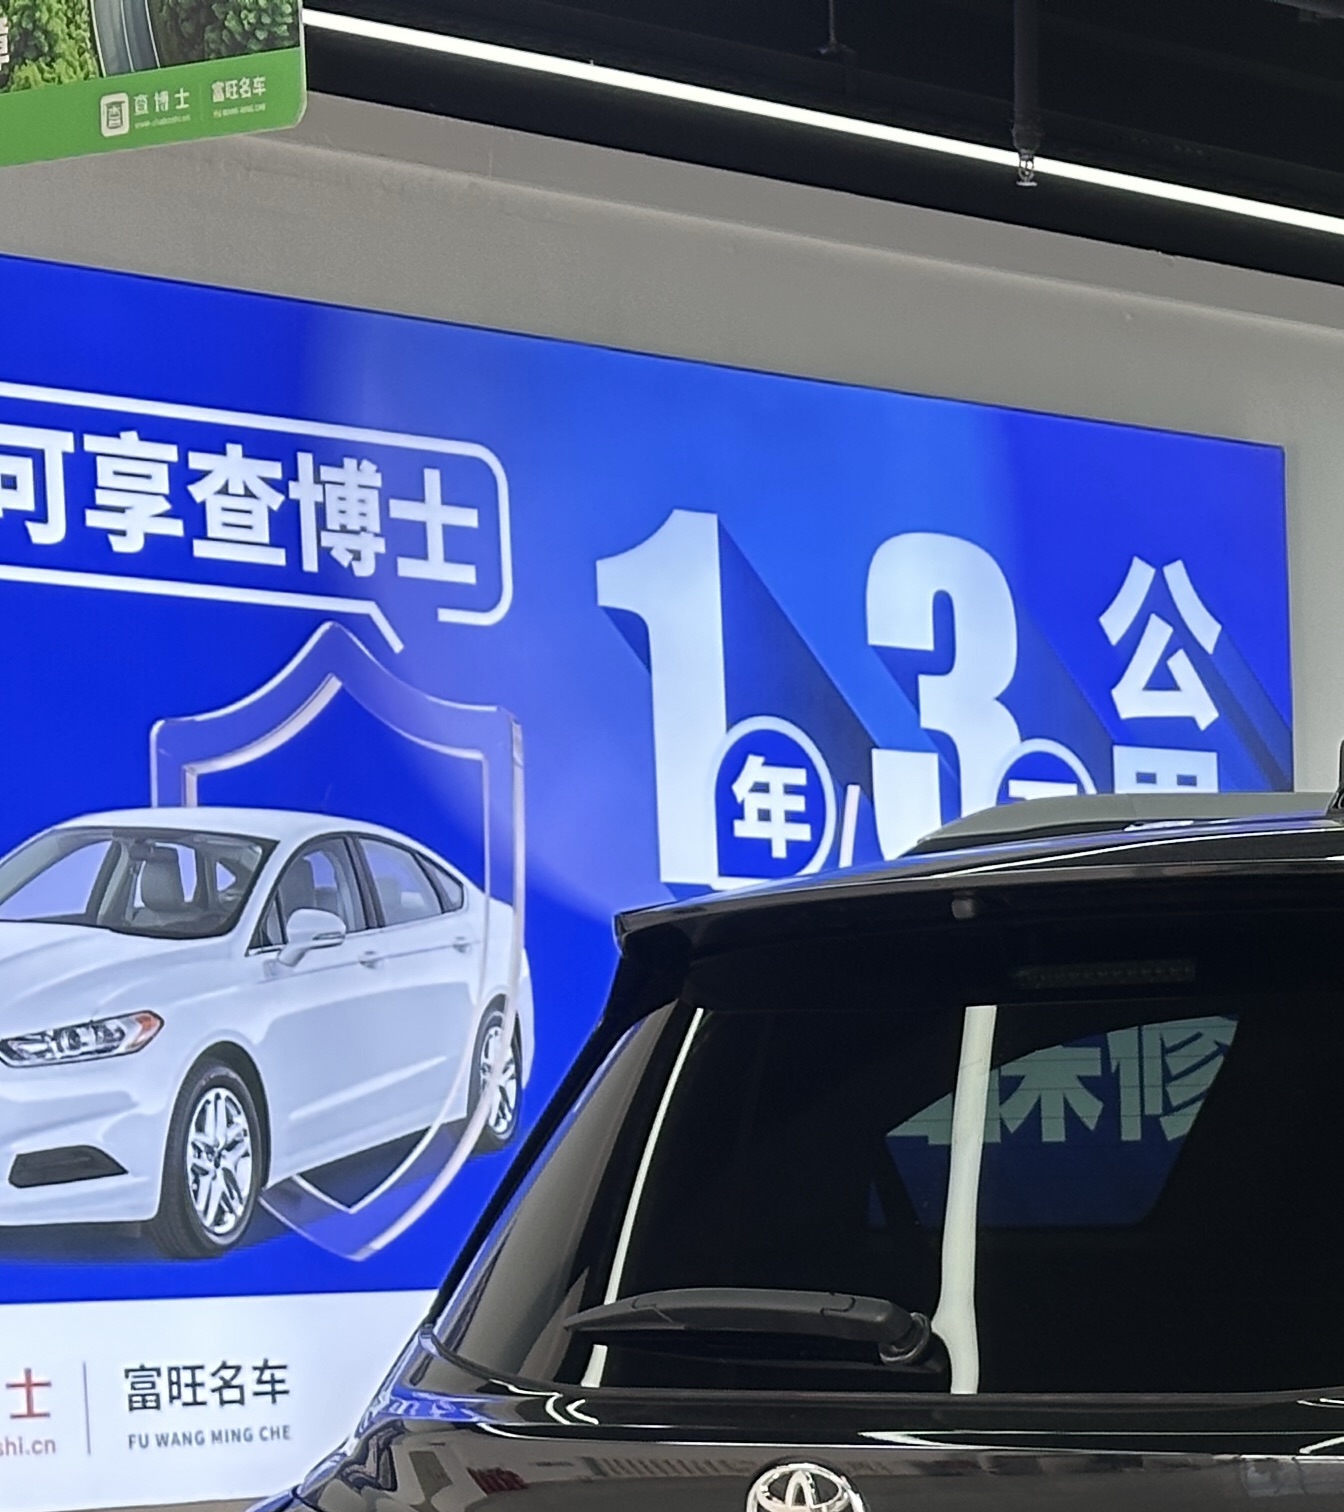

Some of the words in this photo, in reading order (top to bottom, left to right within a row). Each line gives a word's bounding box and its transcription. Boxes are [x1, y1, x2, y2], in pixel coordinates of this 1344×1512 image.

[133, 88, 190, 115] 查博士
[211, 76, 266, 103] 富旺名车
[0, 422, 480, 585] 可享查博士
[124, 1358, 290, 1412] 富旺名车
[128, 1433, 149, 1450] FU
[156, 1430, 205, 1449] WANG
[211, 1427, 254, 1445] MING
[259, 1424, 291, 1442] CHE
